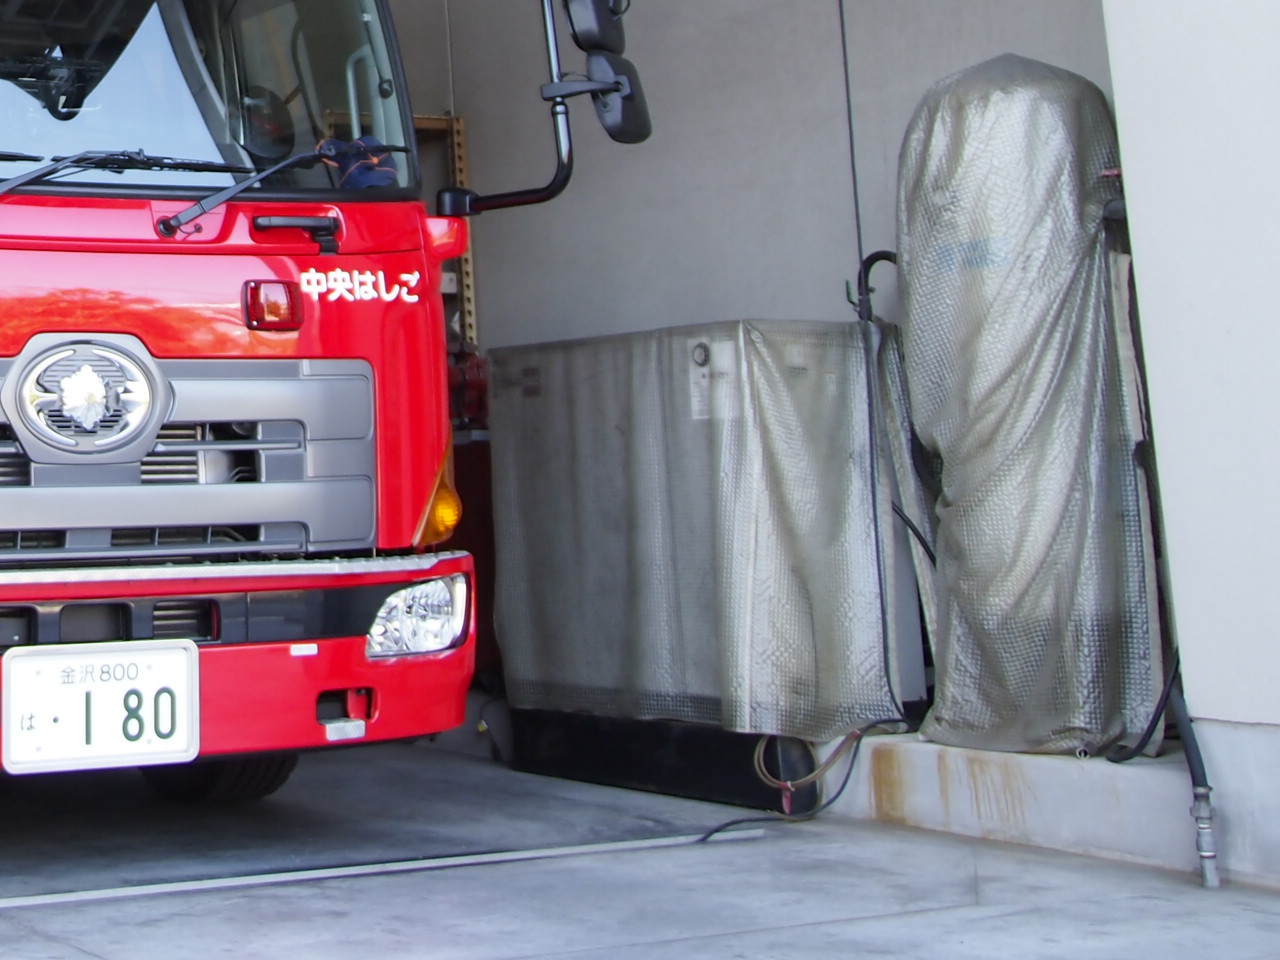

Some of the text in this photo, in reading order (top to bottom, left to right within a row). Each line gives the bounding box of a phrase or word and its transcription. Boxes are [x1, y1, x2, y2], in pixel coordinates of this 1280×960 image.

[300, 268, 420, 303] 中央はしご
